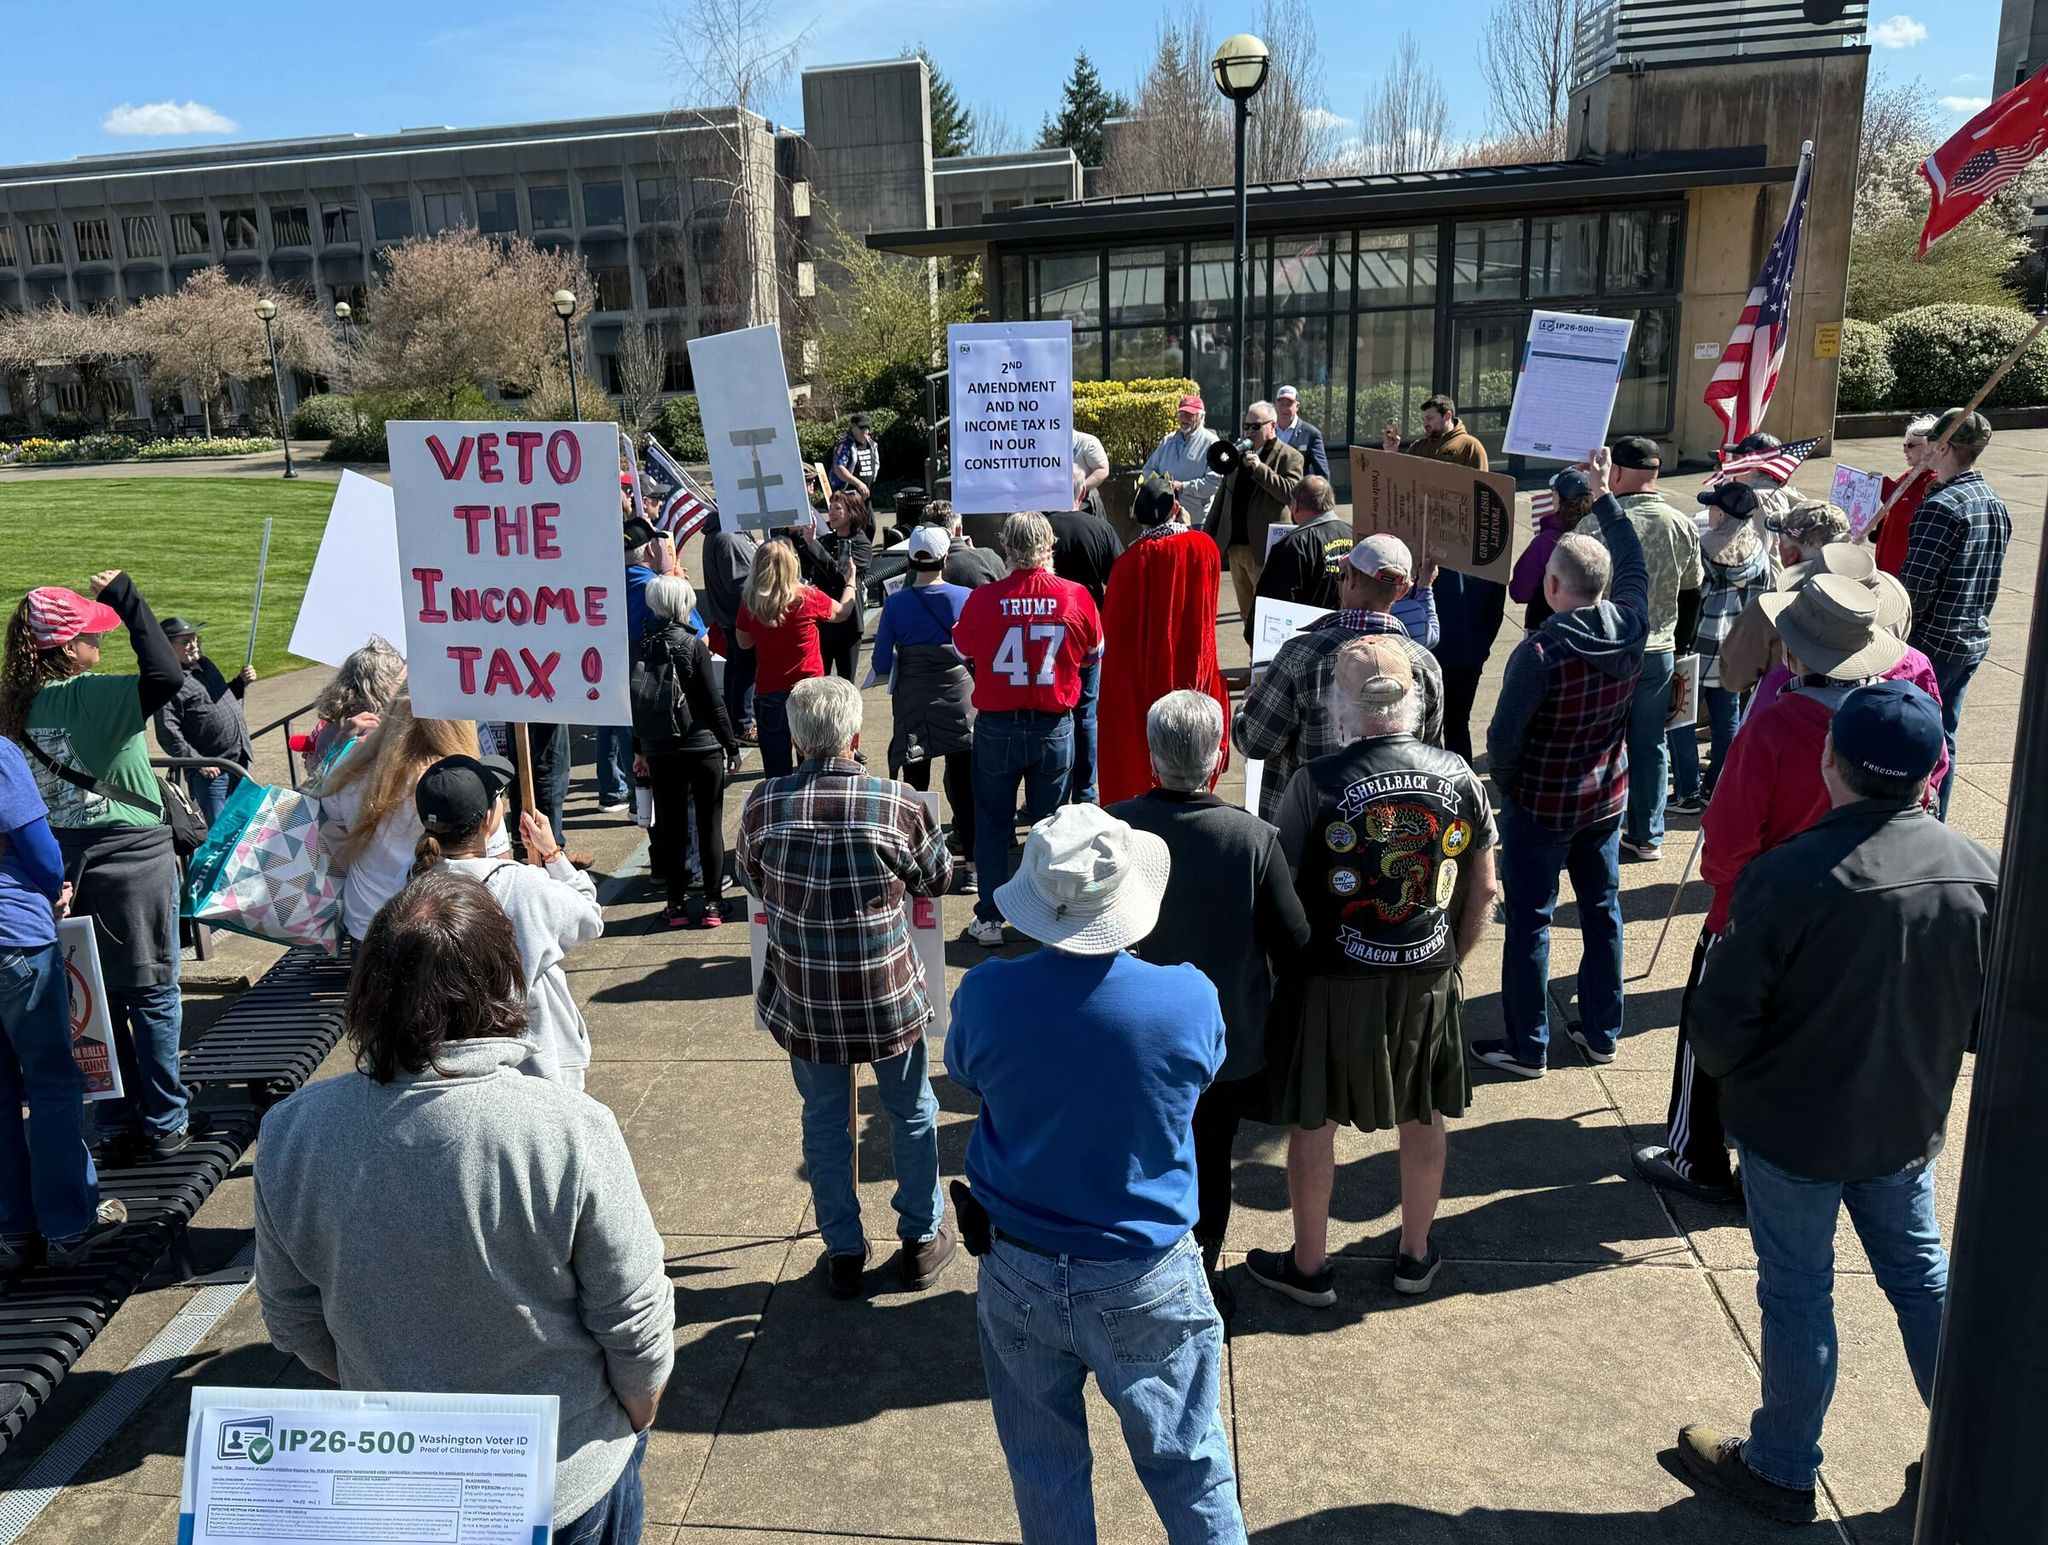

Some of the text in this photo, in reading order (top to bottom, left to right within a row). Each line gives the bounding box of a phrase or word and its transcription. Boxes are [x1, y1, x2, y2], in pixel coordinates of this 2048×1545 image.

[1556, 322, 1594, 332] IP26-500
[1001, 361, 1022, 374] 2ND
[967, 381, 1056, 394] AMENDMENT
[986, 400, 1039, 412] AND NO
[964, 418, 1060, 432] INCOME TAX IS
[989, 438, 1036, 450] IN OUR
[425, 429, 582, 485] VETO
[964, 456, 1060, 470] CONSTITUTION
[453, 502, 562, 560] THE
[1479, 490, 1490, 559] DISPLAY BOARD
[1491, 507, 1501, 548] PROJECT
[1000, 598, 1058, 616] TRUMP
[992, 623, 1066, 687] 47
[1863, 761, 1908, 776] FREEDOM
[1348, 774, 1429, 802] SHELLBACK
[1349, 935, 1445, 963] DRAGON KEEPER
[278, 1429, 528, 1454] IP26-500 Washington Voter ID
[420, 1446, 440, 1454] Proof
[441, 1446, 448, 1454] of
[450, 1446, 489, 1456] Citizenship
[502, 1448, 526, 1456] Voting
